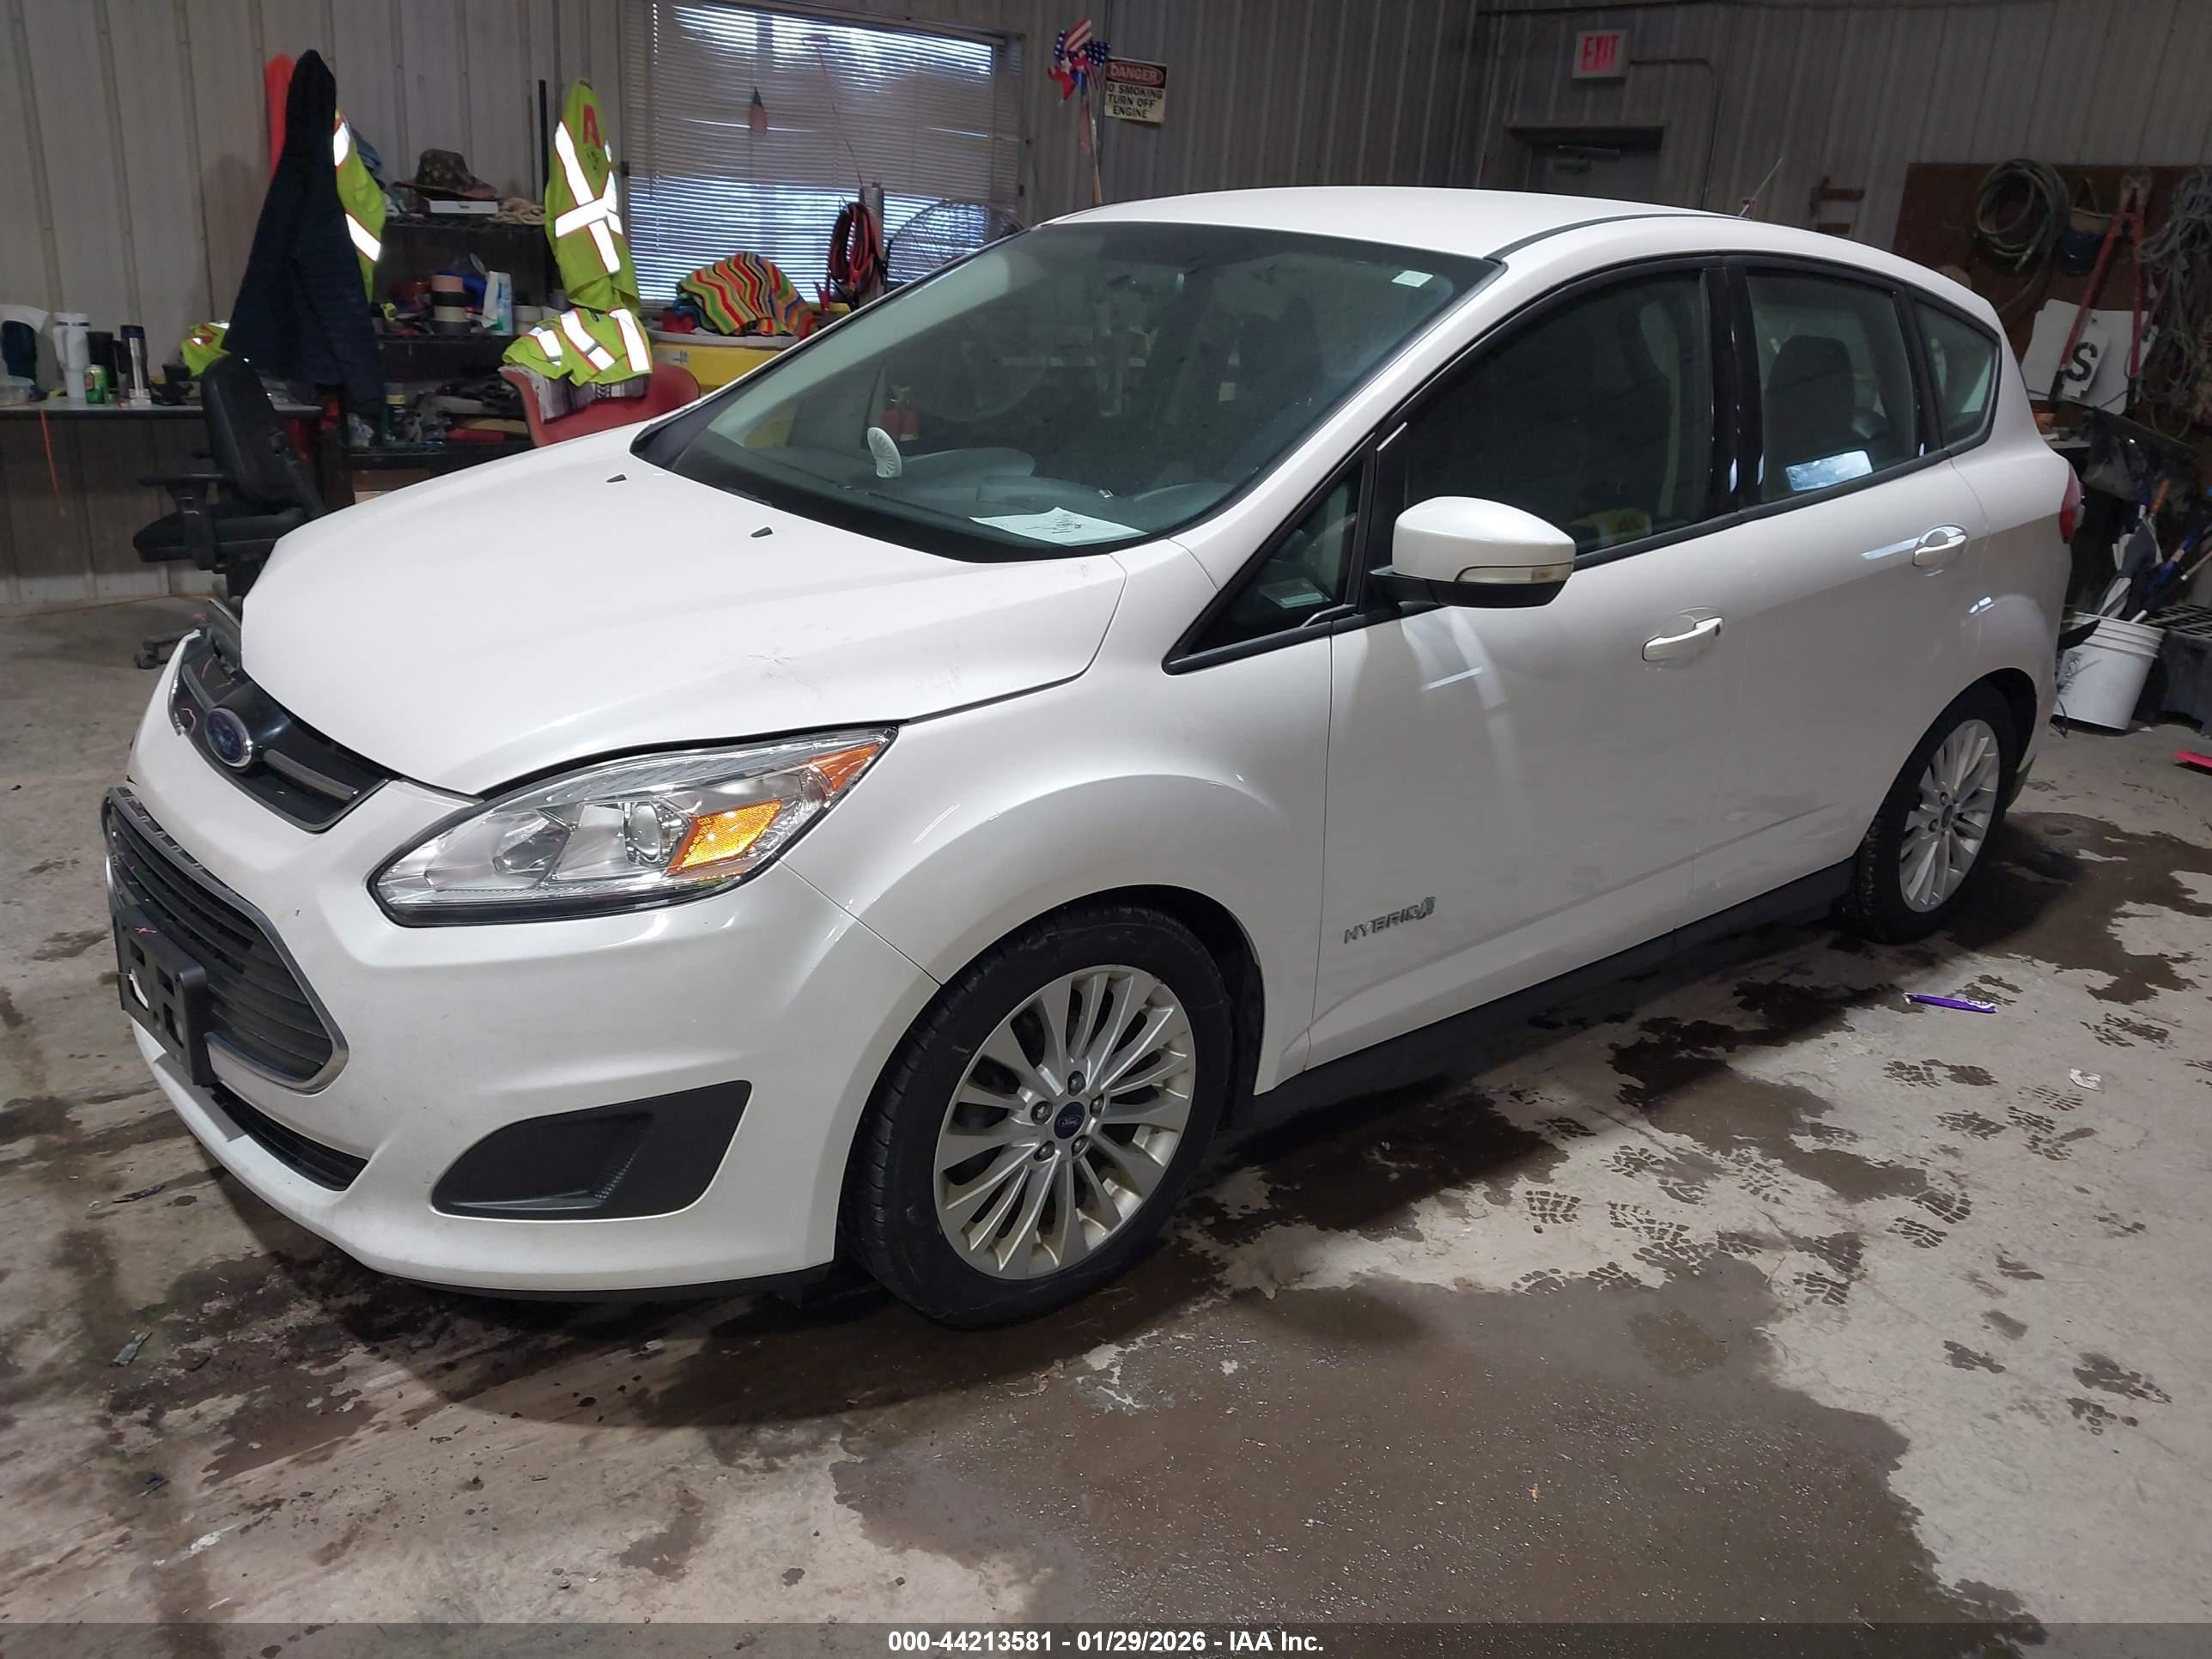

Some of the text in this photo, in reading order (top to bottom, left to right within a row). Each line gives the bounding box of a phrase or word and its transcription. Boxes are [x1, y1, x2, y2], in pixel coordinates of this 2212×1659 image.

[1581, 35, 1621, 70] EXIT
[1110, 65, 1158, 82] DANGER
[1118, 84, 1164, 100] SMOKING
[1108, 94, 1157, 108] TURN OFF
[1112, 105, 1149, 118] ENGINE
[2066, 342, 2098, 382] S
